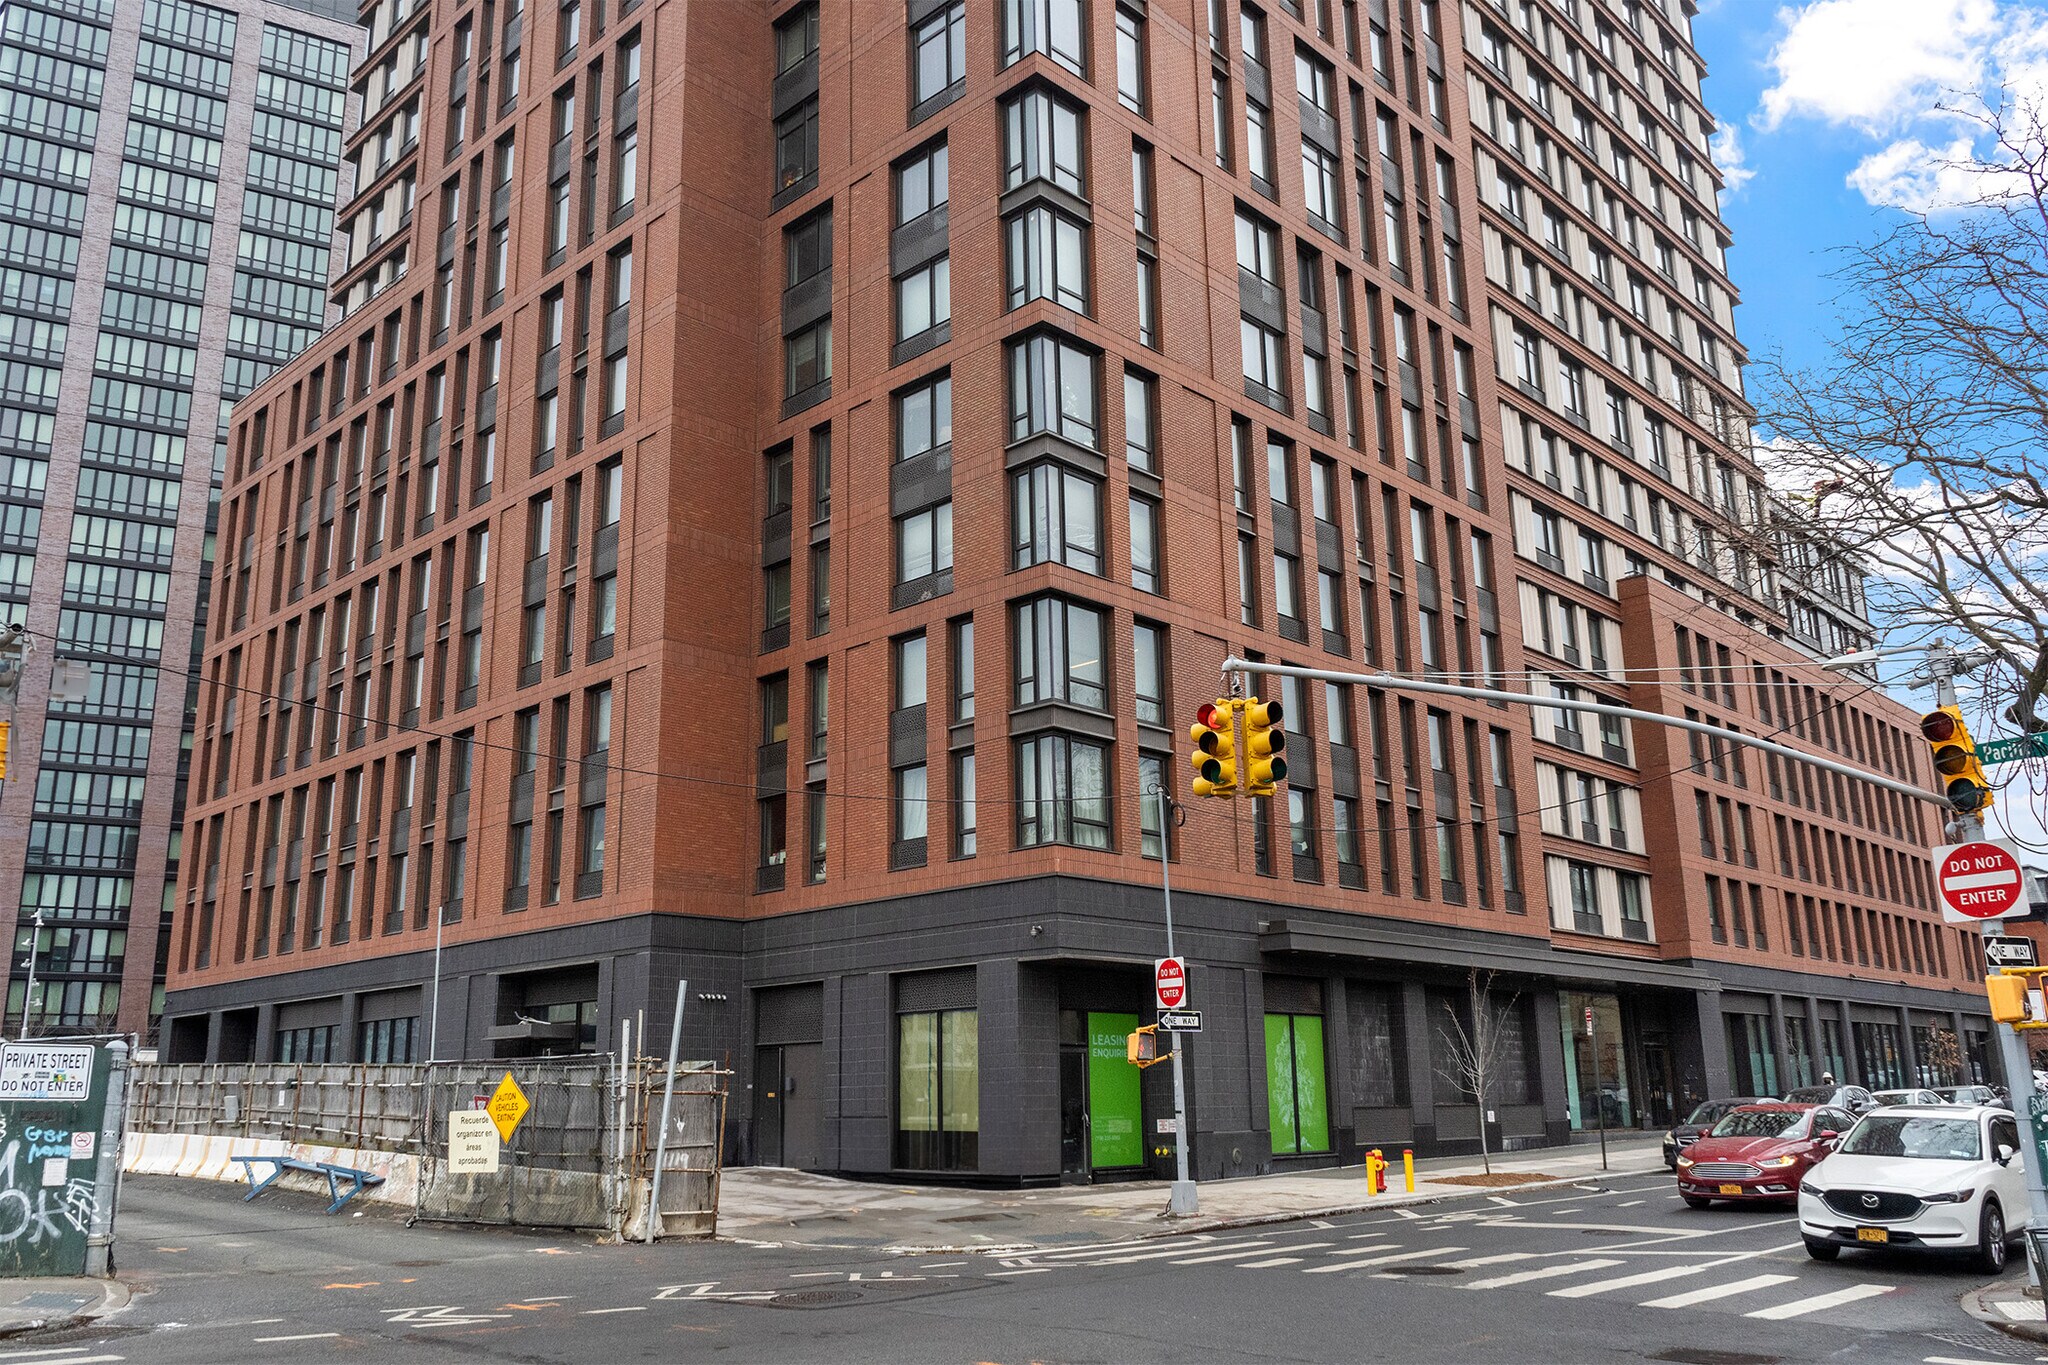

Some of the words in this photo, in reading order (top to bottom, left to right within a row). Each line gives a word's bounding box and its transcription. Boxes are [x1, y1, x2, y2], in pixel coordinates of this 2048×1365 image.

[1950, 860, 1970, 873] DO
[1975, 855, 2003, 870] NOT
[1959, 889, 2007, 905] ENTER
[1991, 945, 2007, 958] ONE
[2012, 945, 2029, 958] WAY
[1160, 969, 1169, 977] DO
[1169, 967, 1179, 976] NOT
[1162, 989, 1180, 998] ENTER
[1164, 1016, 1177, 1025] ONE
[1182, 1017, 1196, 1025] WAY
[1092, 1034, 1129, 1046] LEASIN
[1092, 1048, 1129, 1059] ENQUIRIE
[5, 1053, 48, 1069] PRIVATE
[50, 1053, 87, 1069] STREET
[2, 1080, 18, 1092] DO
[21, 1080, 45, 1092] NOT
[47, 1080, 84, 1092] ENTER
[495, 1092, 517, 1103] CAUTION
[495, 1102, 519, 1112] VEHICLES
[460, 1116, 490, 1125] Recuerde
[496, 1113, 516, 1123] EXITING
[458, 1157, 488, 1166] aprobadas
